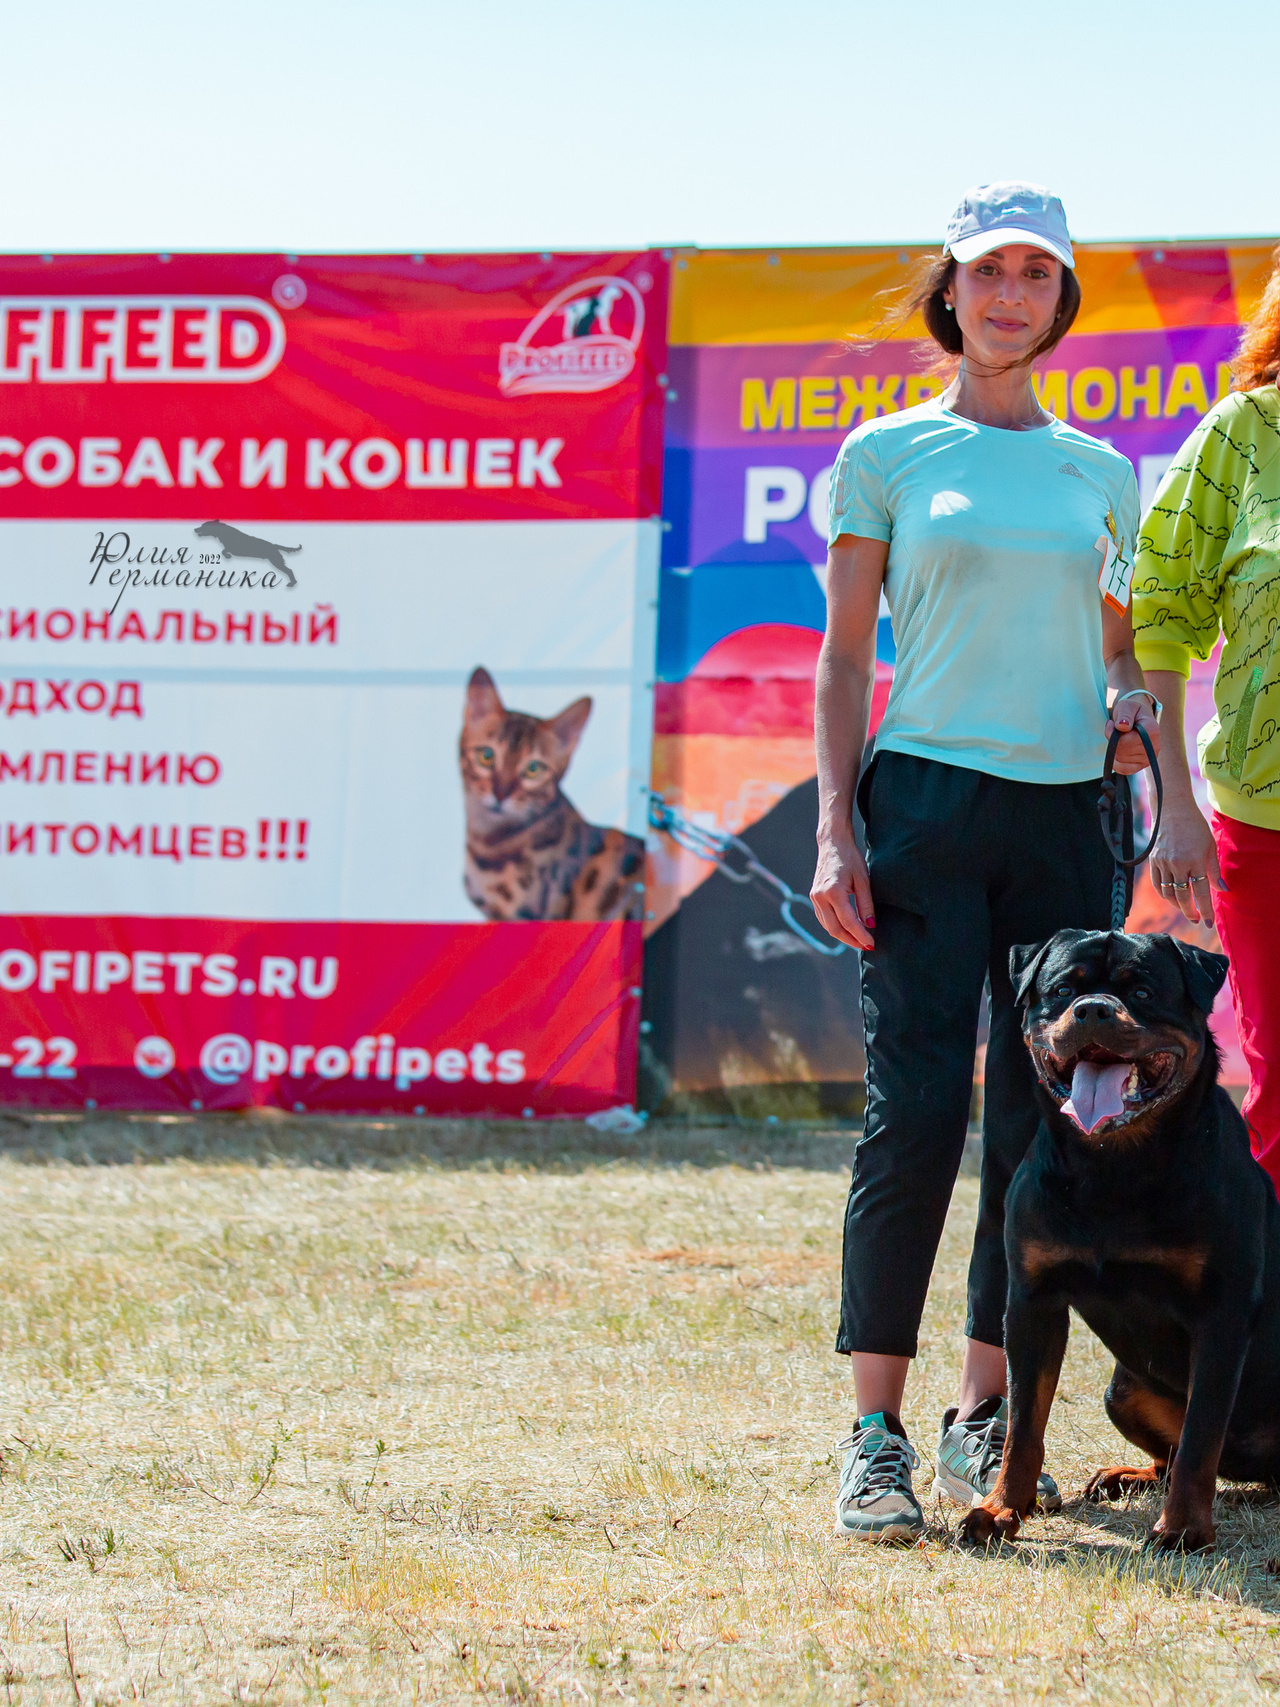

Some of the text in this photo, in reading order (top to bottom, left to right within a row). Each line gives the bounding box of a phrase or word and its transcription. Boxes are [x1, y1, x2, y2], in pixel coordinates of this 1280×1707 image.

[240, 437, 288, 488] И
[305, 437, 564, 488] КОШЕК
[1108, 554, 1129, 597] 17
[0, 603, 339, 644] ИОНАЛЬНЫЙ
[0, 680, 143, 720] ДХОД
[0, 818, 310, 862] ИТОМЦЕВ!!!
[0, 948, 338, 999] OFIPETS.RU
[200, 1033, 527, 1091] @profipets
